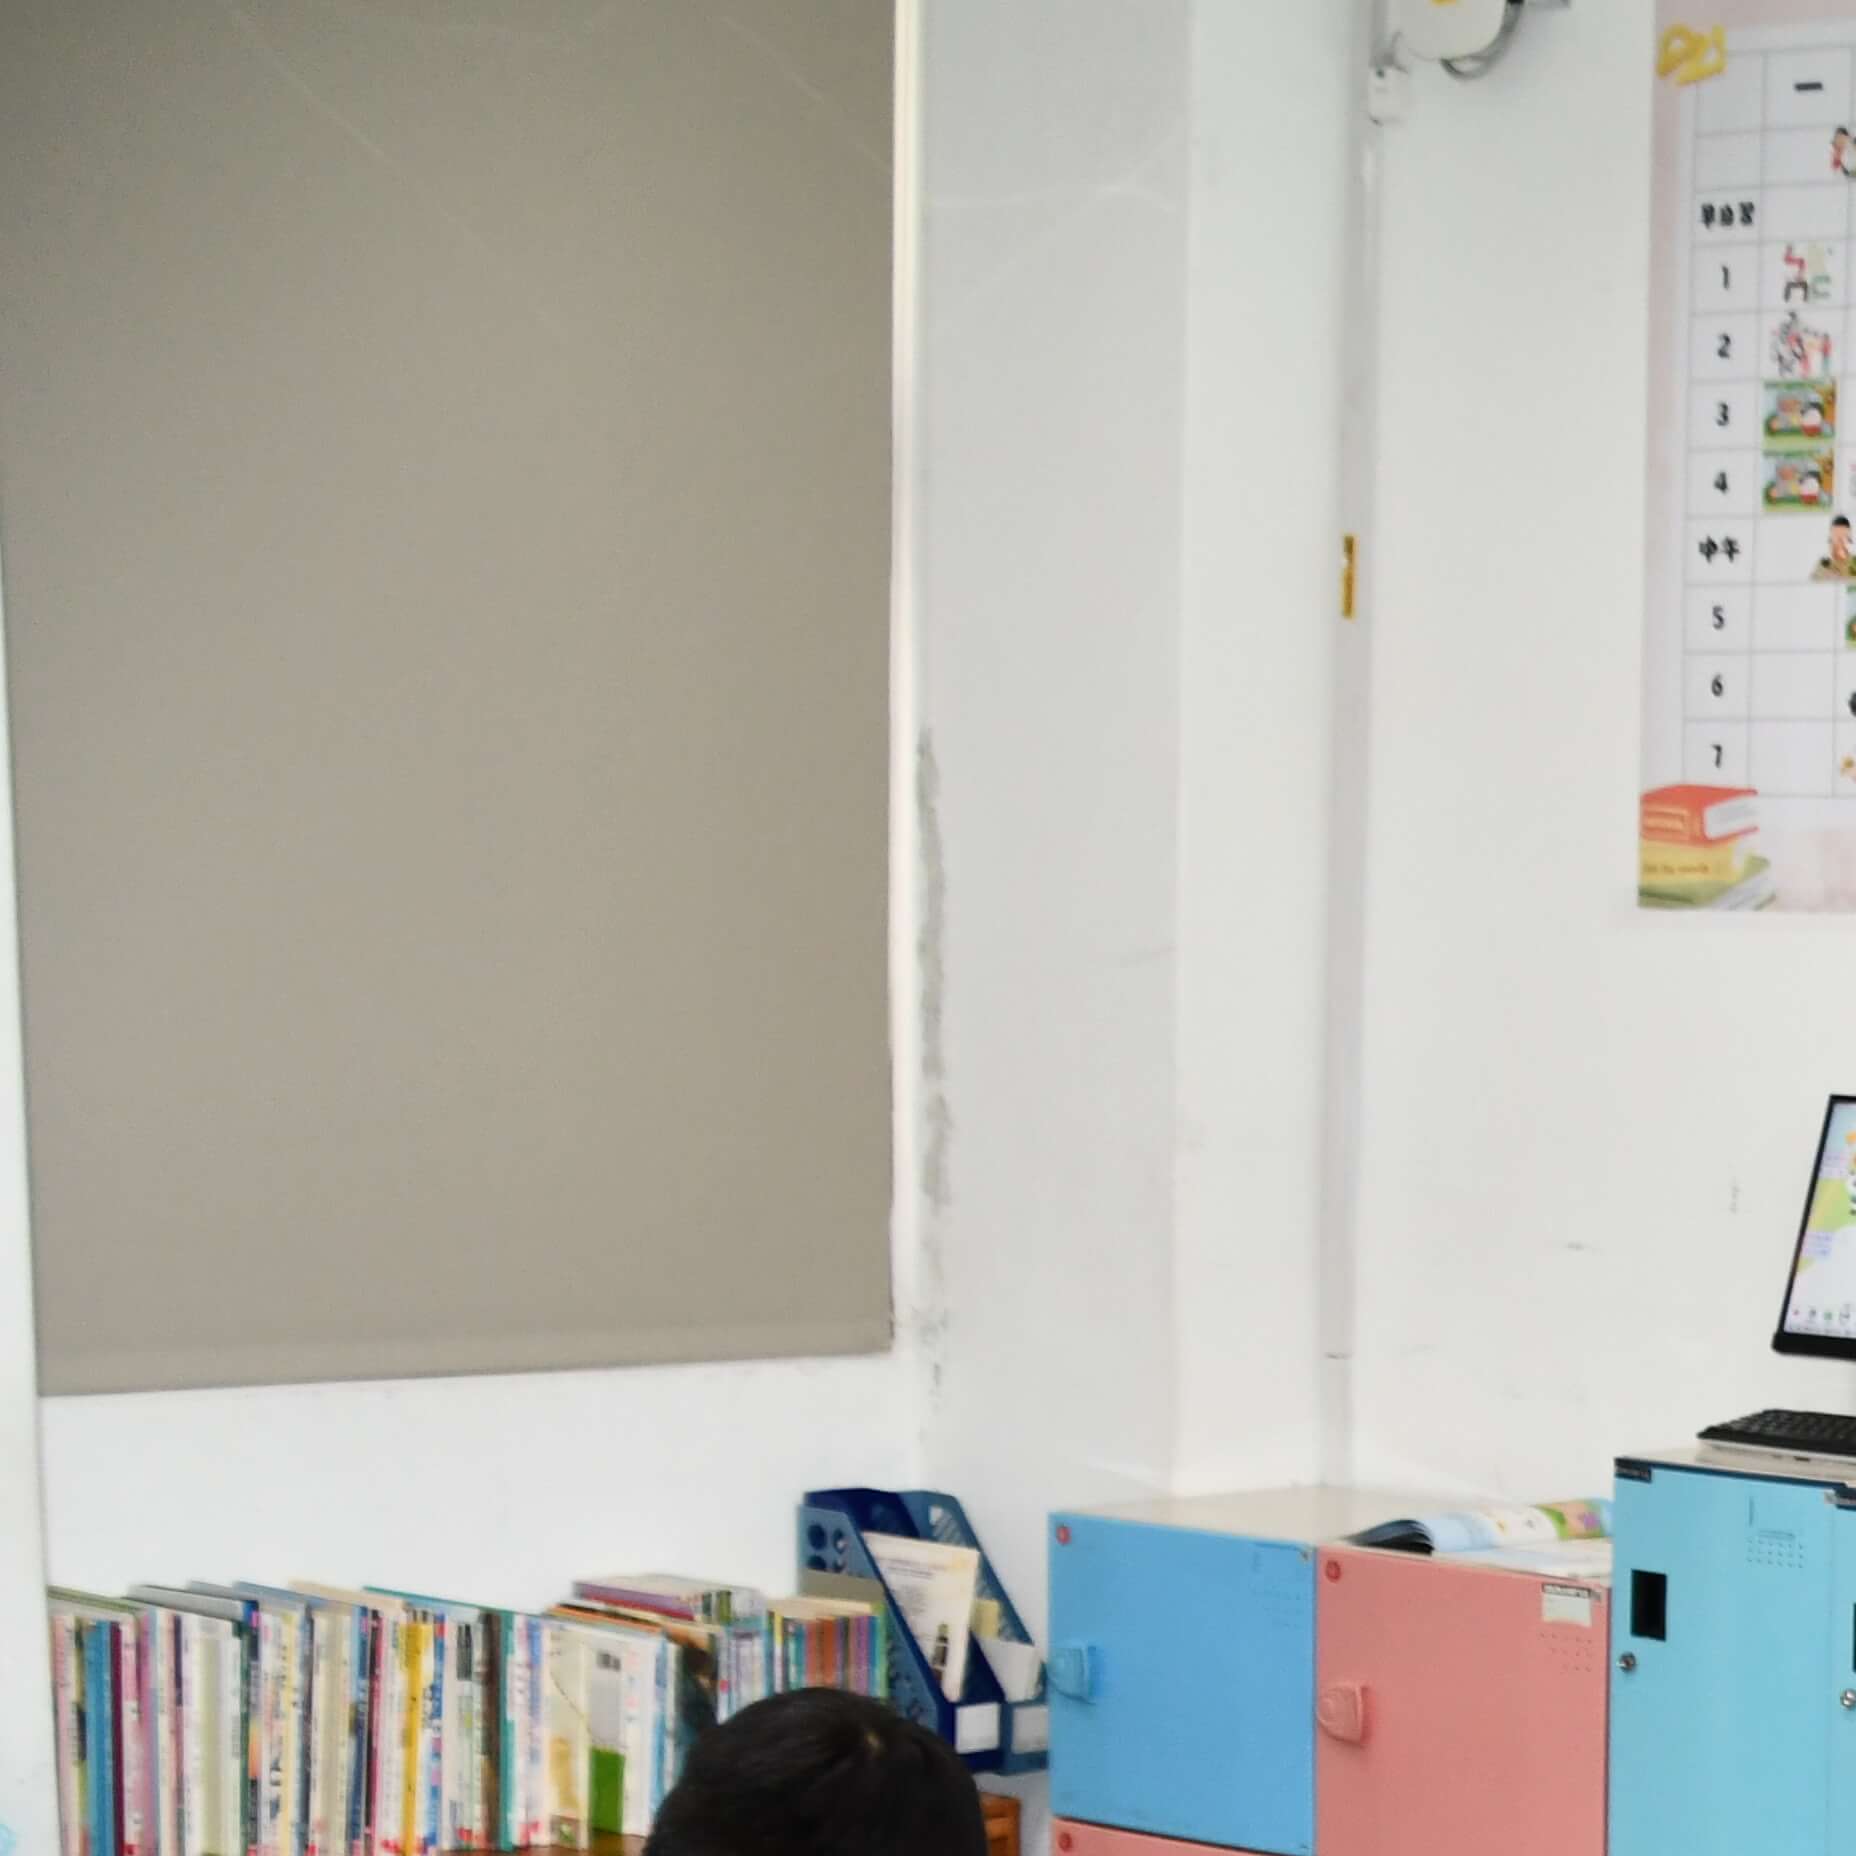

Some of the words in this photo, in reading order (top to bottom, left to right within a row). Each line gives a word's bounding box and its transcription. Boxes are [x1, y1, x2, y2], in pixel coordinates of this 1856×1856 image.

[1718, 334, 1731, 360] 2
[1717, 403, 1729, 428] 3
[1714, 473, 1729, 495] 4
[1712, 606, 1725, 630] 5
[1711, 673, 1724, 697] 6
[1712, 743, 1723, 768] 7
